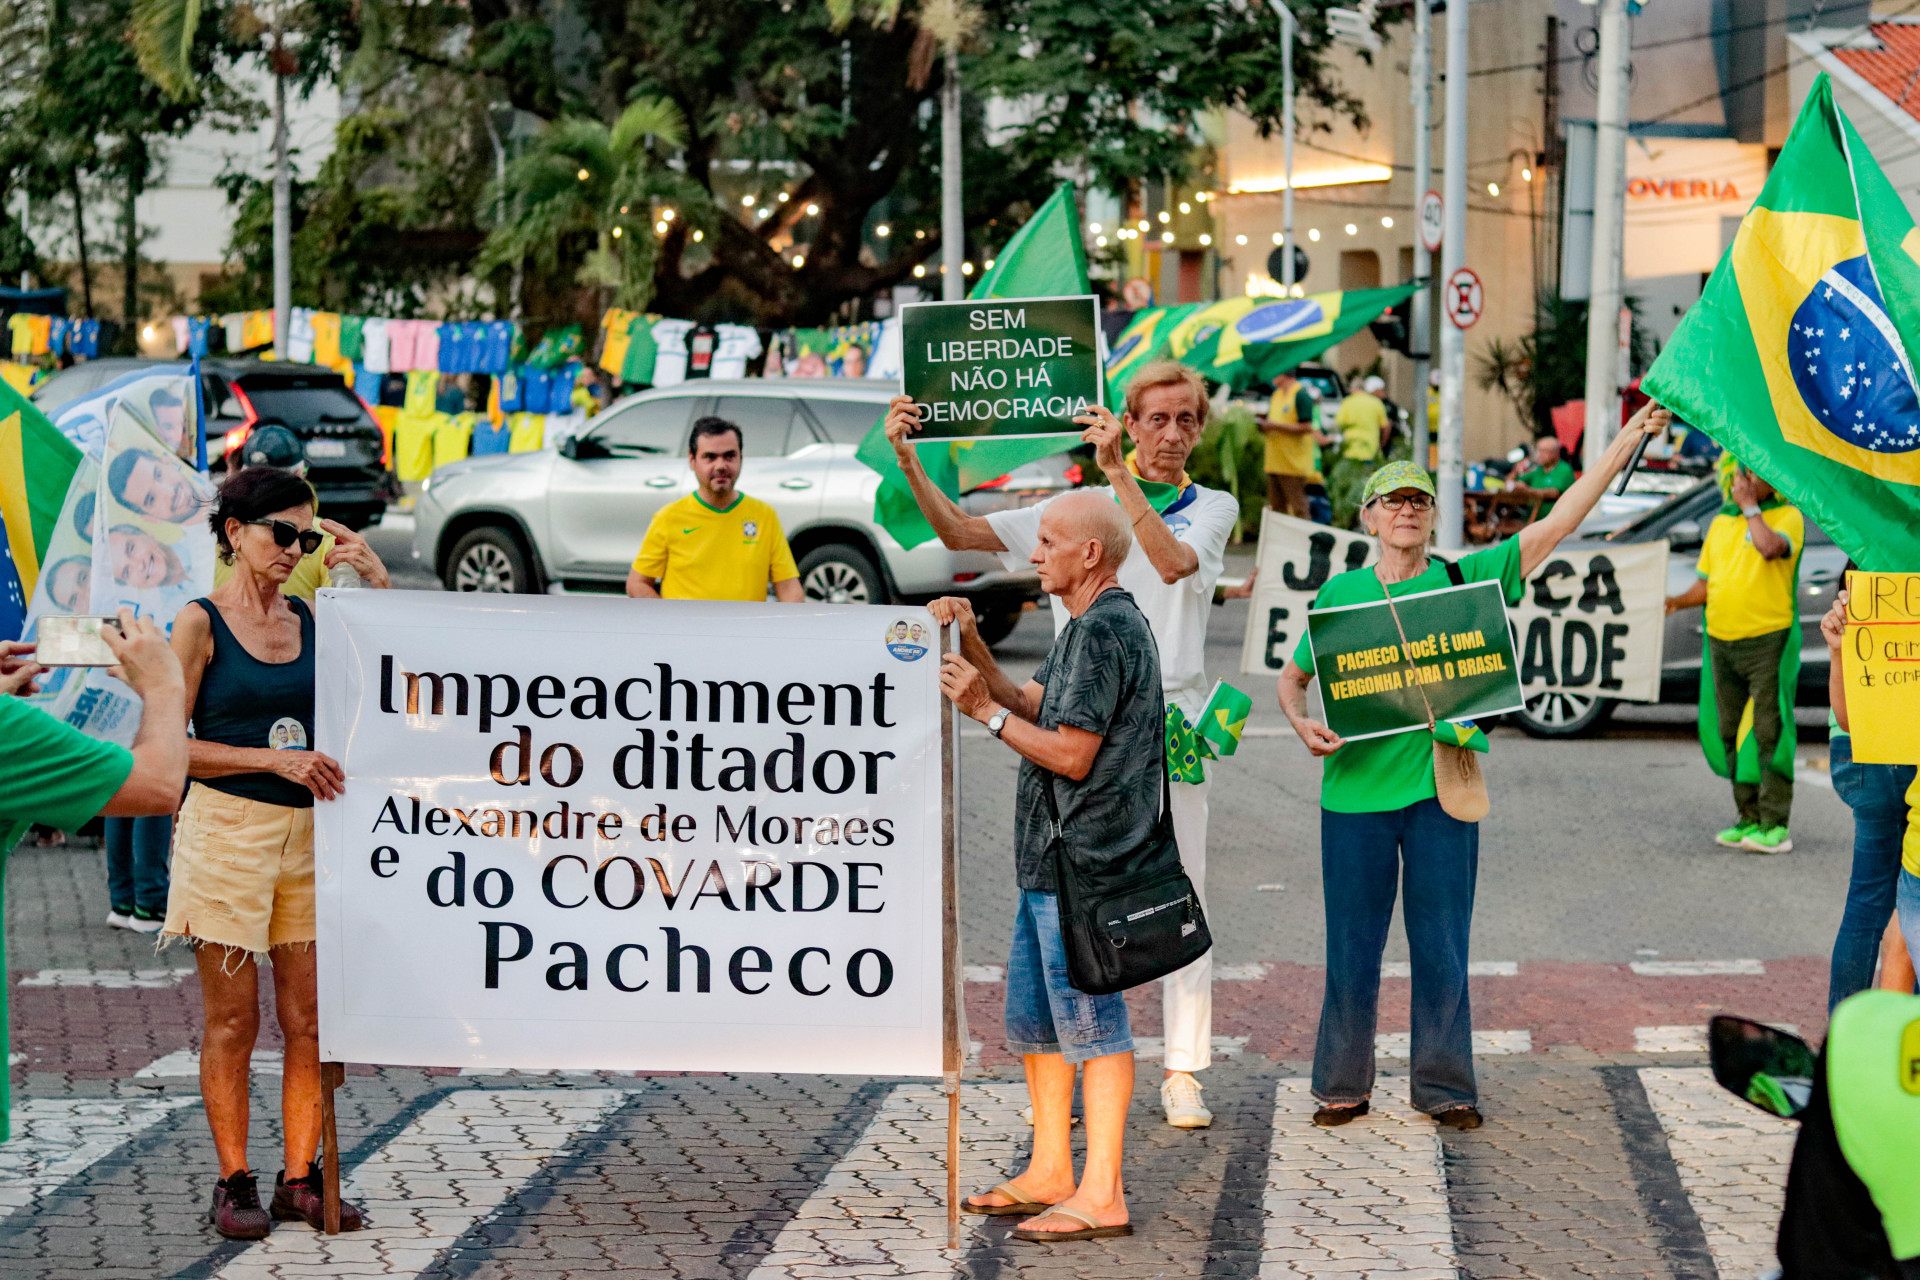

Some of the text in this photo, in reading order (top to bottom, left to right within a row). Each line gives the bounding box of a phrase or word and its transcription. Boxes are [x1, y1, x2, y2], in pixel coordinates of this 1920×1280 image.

[969, 308, 1026, 330] SEM
[927, 336, 1073, 363] LIBERDADE
[951, 361, 1052, 391] NÃO HÁ
[915, 396, 1091, 423] DEMOCRACIA
[1337, 630, 1486, 673] PACHECO VOCÊ É UMA
[1856, 627, 1873, 661] O
[379, 654, 897, 734] Impeachment
[1329, 653, 1507, 701] VERGONHA PARA O BRASIL
[489, 724, 897, 795] do ditador
[371, 795, 896, 848] Alexandre de Moraes
[370, 845, 885, 914] e do COVARDE
[478, 921, 894, 998] Pacheco
